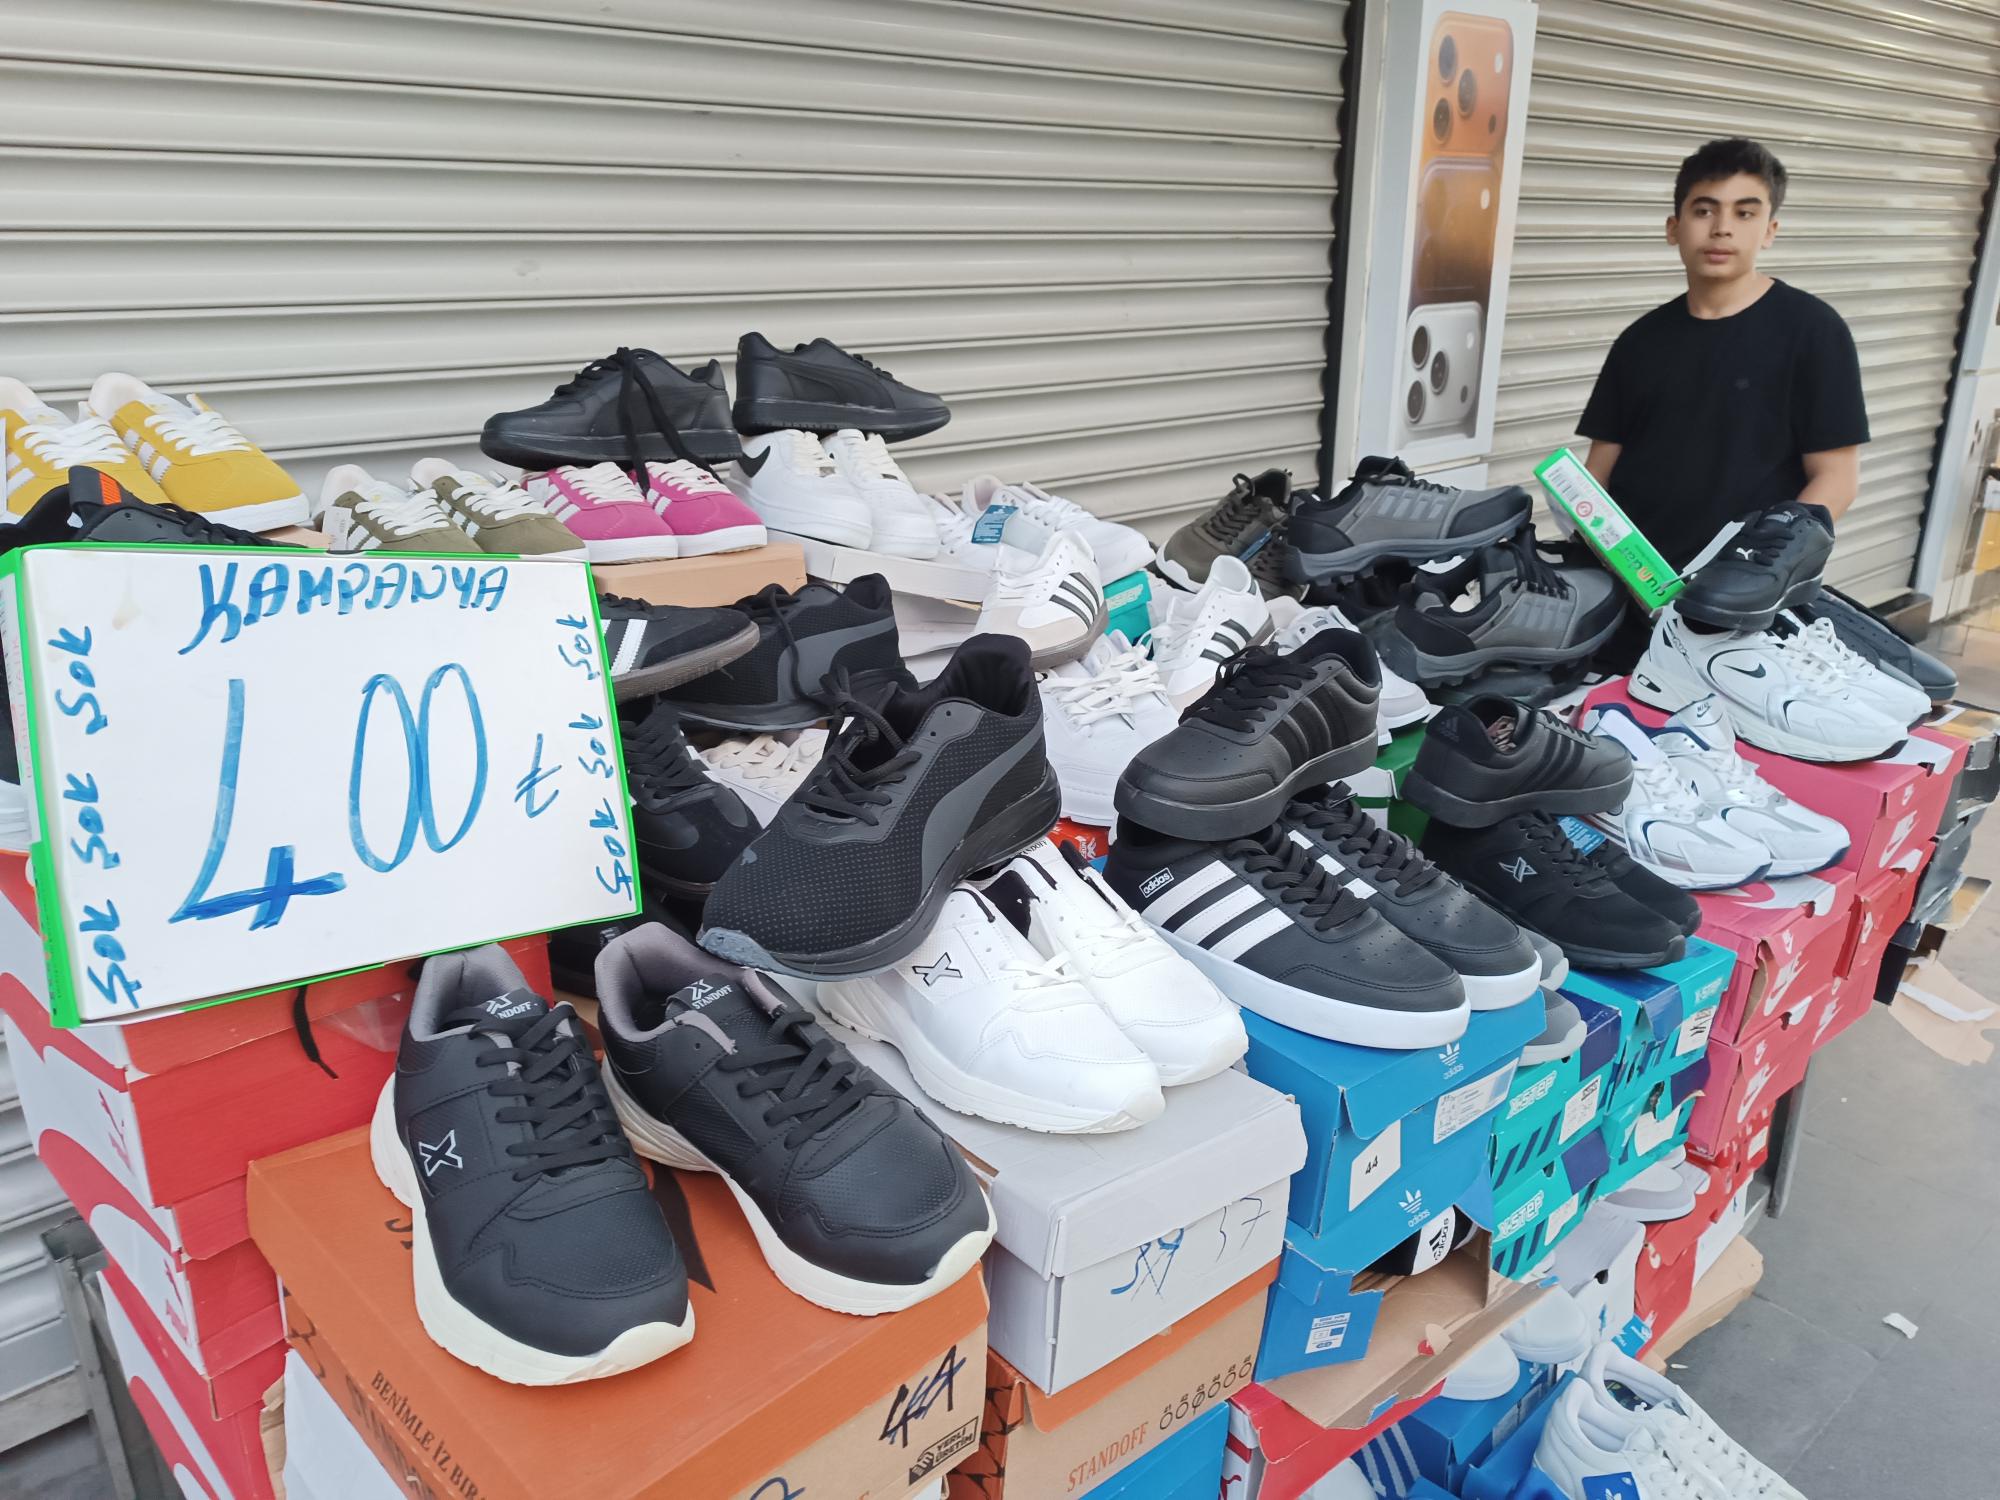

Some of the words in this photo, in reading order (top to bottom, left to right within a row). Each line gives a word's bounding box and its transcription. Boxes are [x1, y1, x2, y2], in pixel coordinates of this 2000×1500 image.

[178, 561, 509, 656] KAMPANYA
[167, 662, 489, 932] 400
[1143, 872, 1171, 895] adidas
[691, 984, 733, 1010] STANDOFF
[1364, 1154, 1379, 1175] 44
[1408, 1208, 1431, 1228] adidas
[371, 1369, 435, 1451] BENİMLE
[1065, 1420, 1150, 1494] STANDOFF
